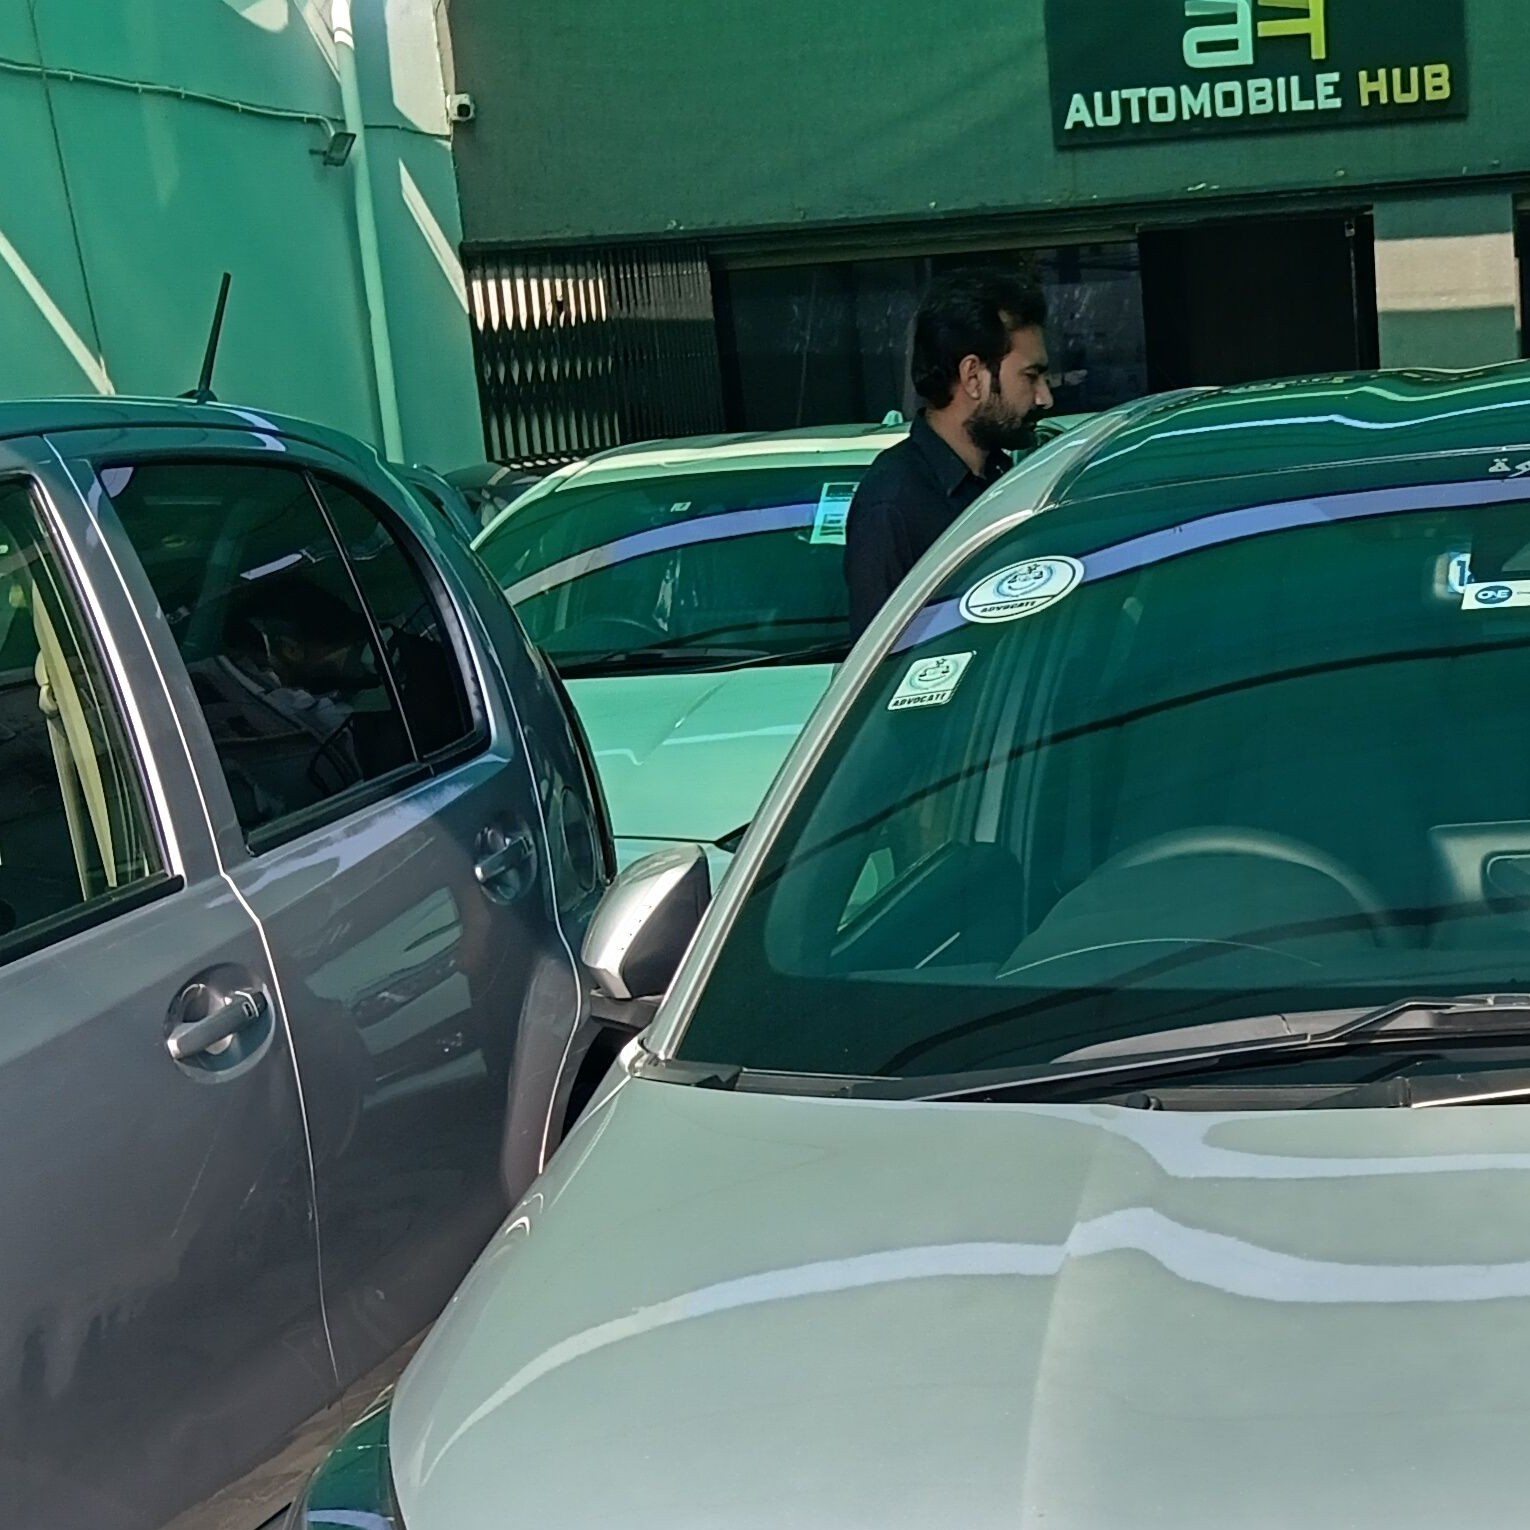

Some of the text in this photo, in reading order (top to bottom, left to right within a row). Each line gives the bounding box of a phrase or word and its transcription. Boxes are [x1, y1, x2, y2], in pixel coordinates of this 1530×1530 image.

[1064, 63, 1452, 130] AUTOMOBILE HUB
[980, 601, 1037, 613] ADVOCATE
[891, 692, 948, 707] ADVOCATE
